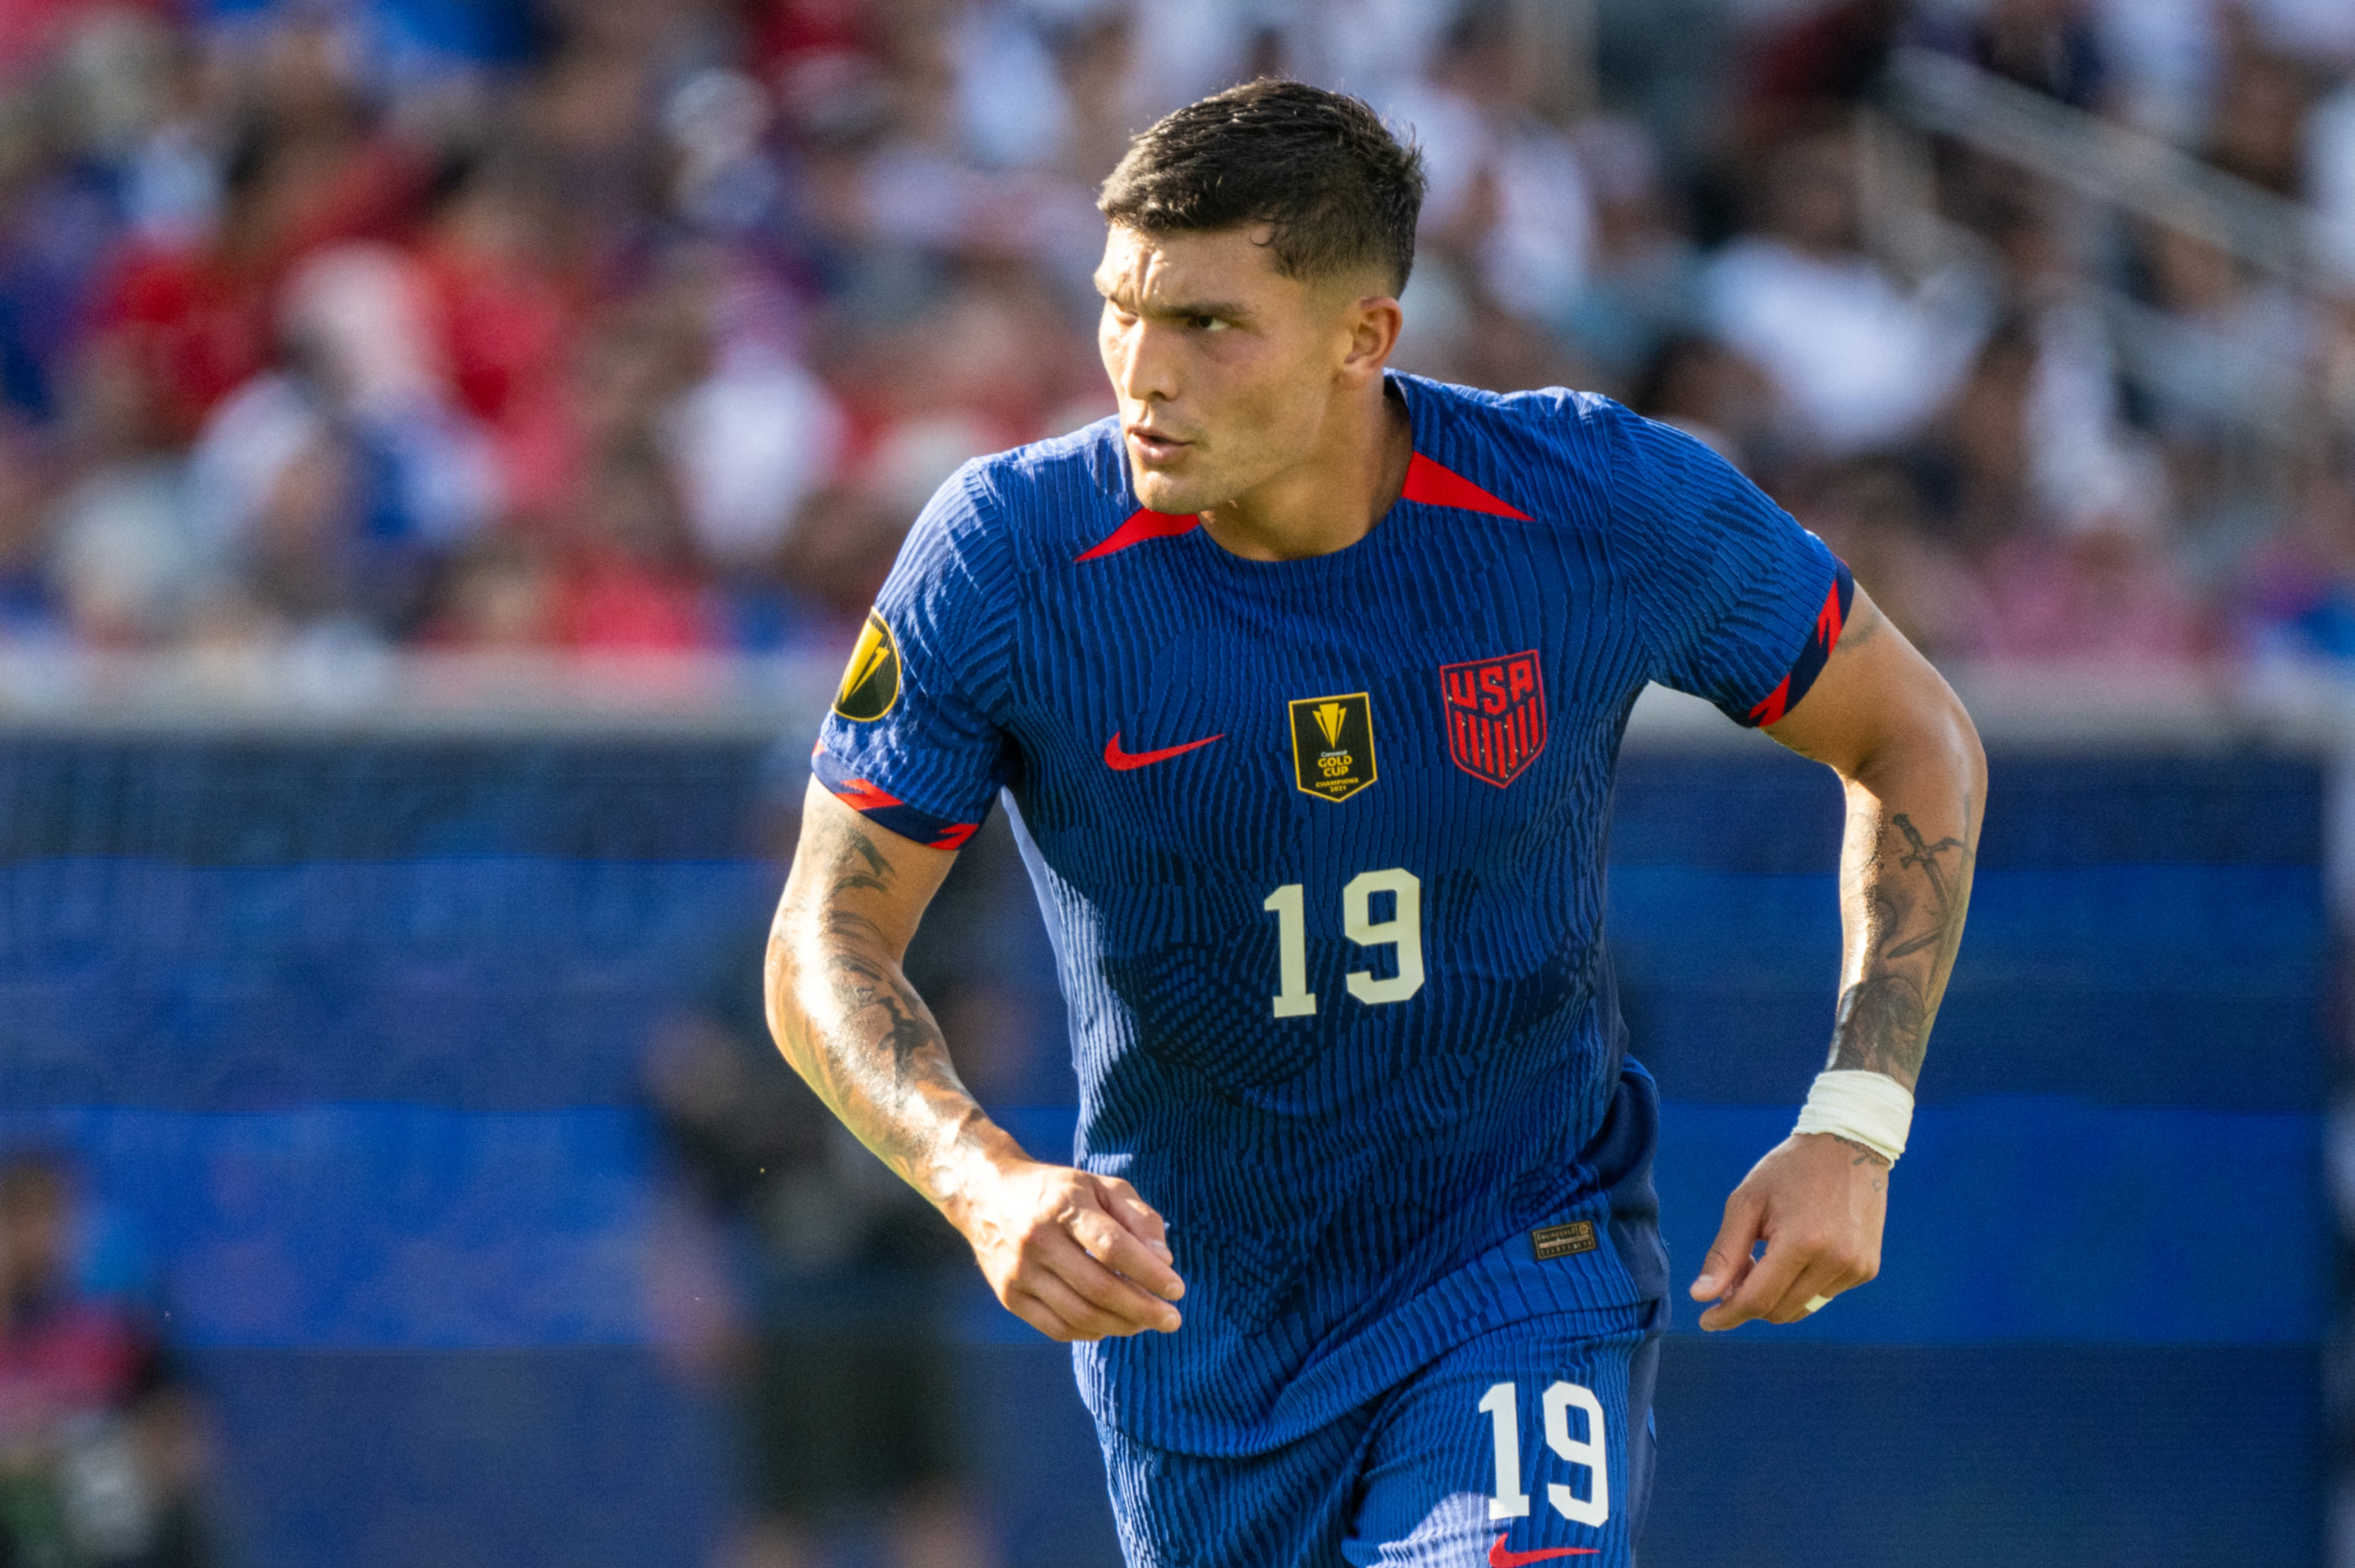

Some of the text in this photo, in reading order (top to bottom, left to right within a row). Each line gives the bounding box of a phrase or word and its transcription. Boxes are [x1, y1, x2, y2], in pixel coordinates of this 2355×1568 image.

[1449, 659, 1534, 715] USA
[1317, 755, 1352, 768] GOLD
[1323, 765, 1349, 777] CUP
[1315, 777, 1359, 788] CHAMPIONS
[1264, 867, 1425, 1018] 19
[1478, 1380, 1609, 1528] 19
